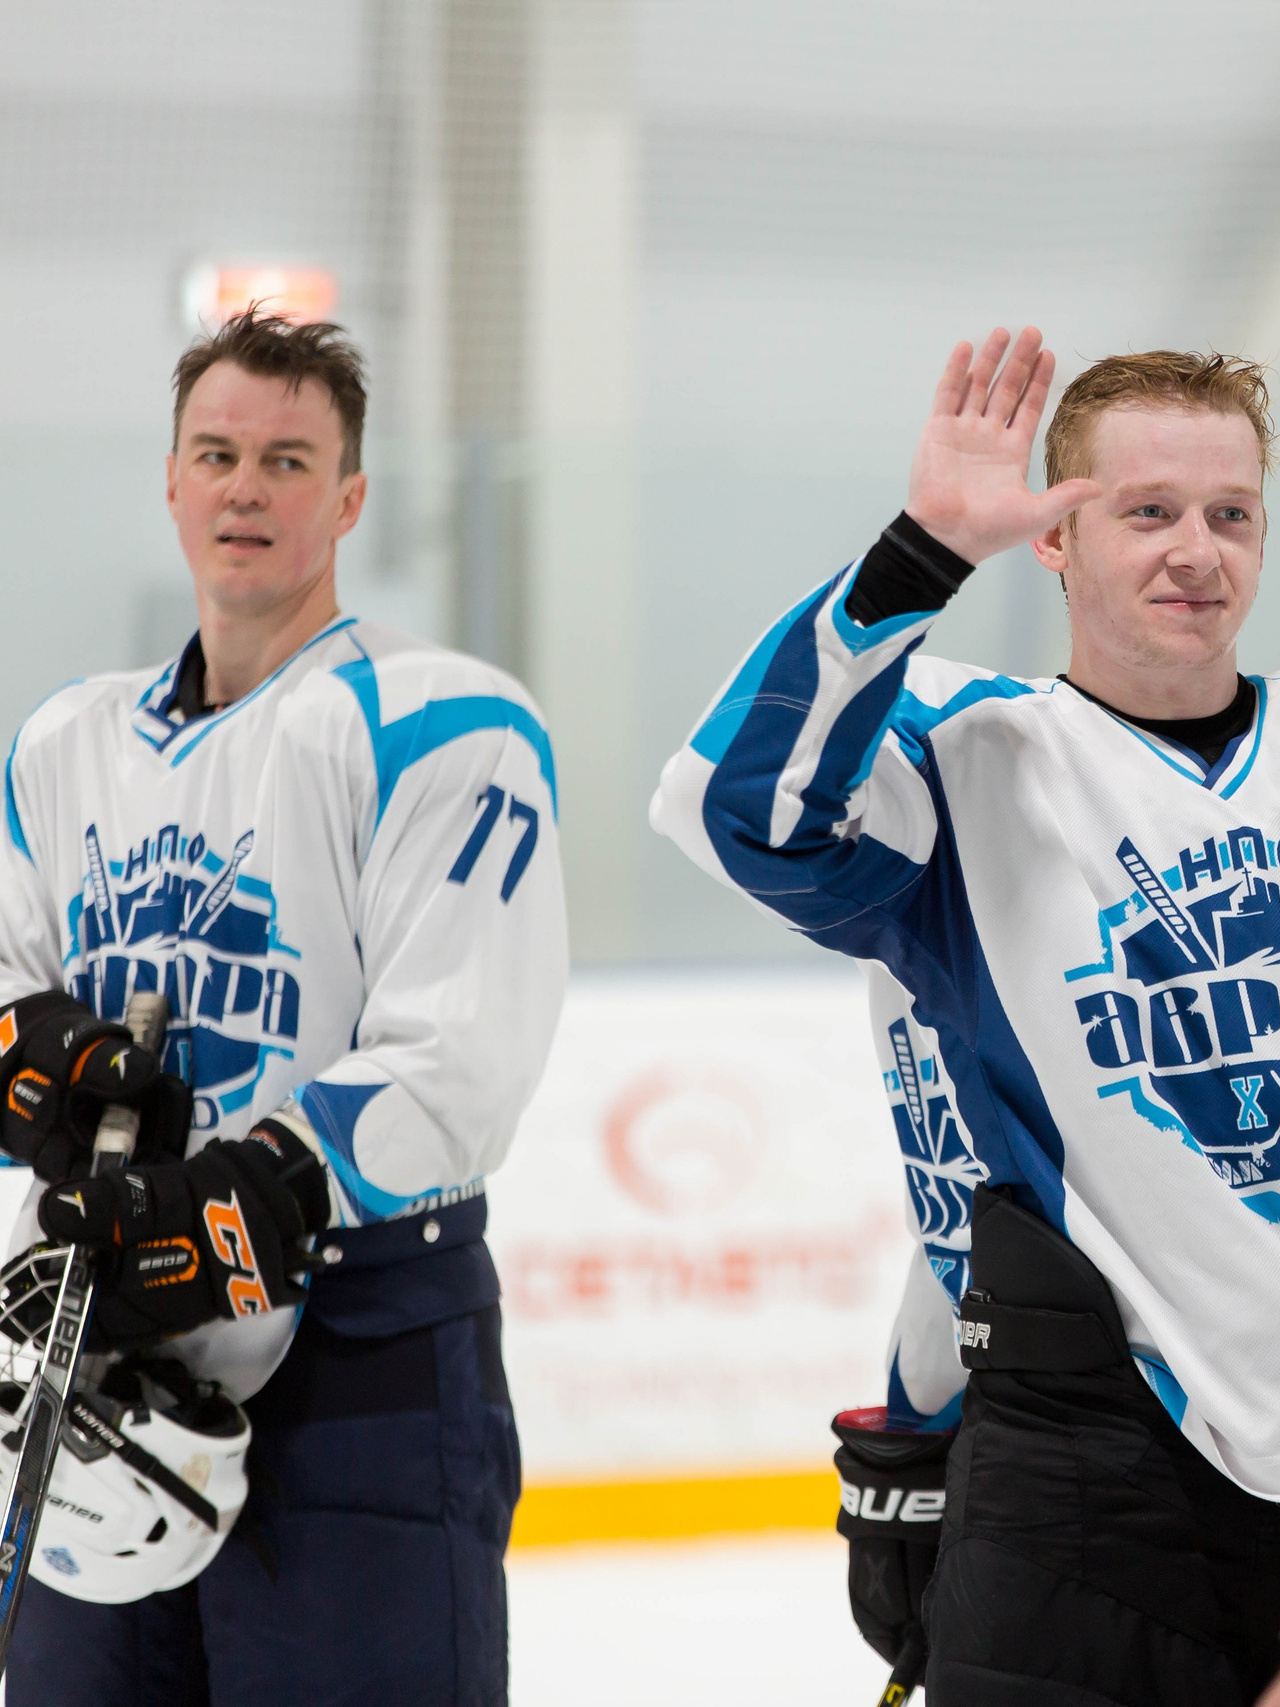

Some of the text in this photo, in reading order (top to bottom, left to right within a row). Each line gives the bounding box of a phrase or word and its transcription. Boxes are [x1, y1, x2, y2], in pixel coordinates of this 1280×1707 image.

[122, 824, 206, 883] НПО
[446, 784, 538, 906] 77
[203, 1186, 273, 1320] CC
[46, 1494, 105, 1525] BAUE
[840, 1480, 947, 1522] AUE
